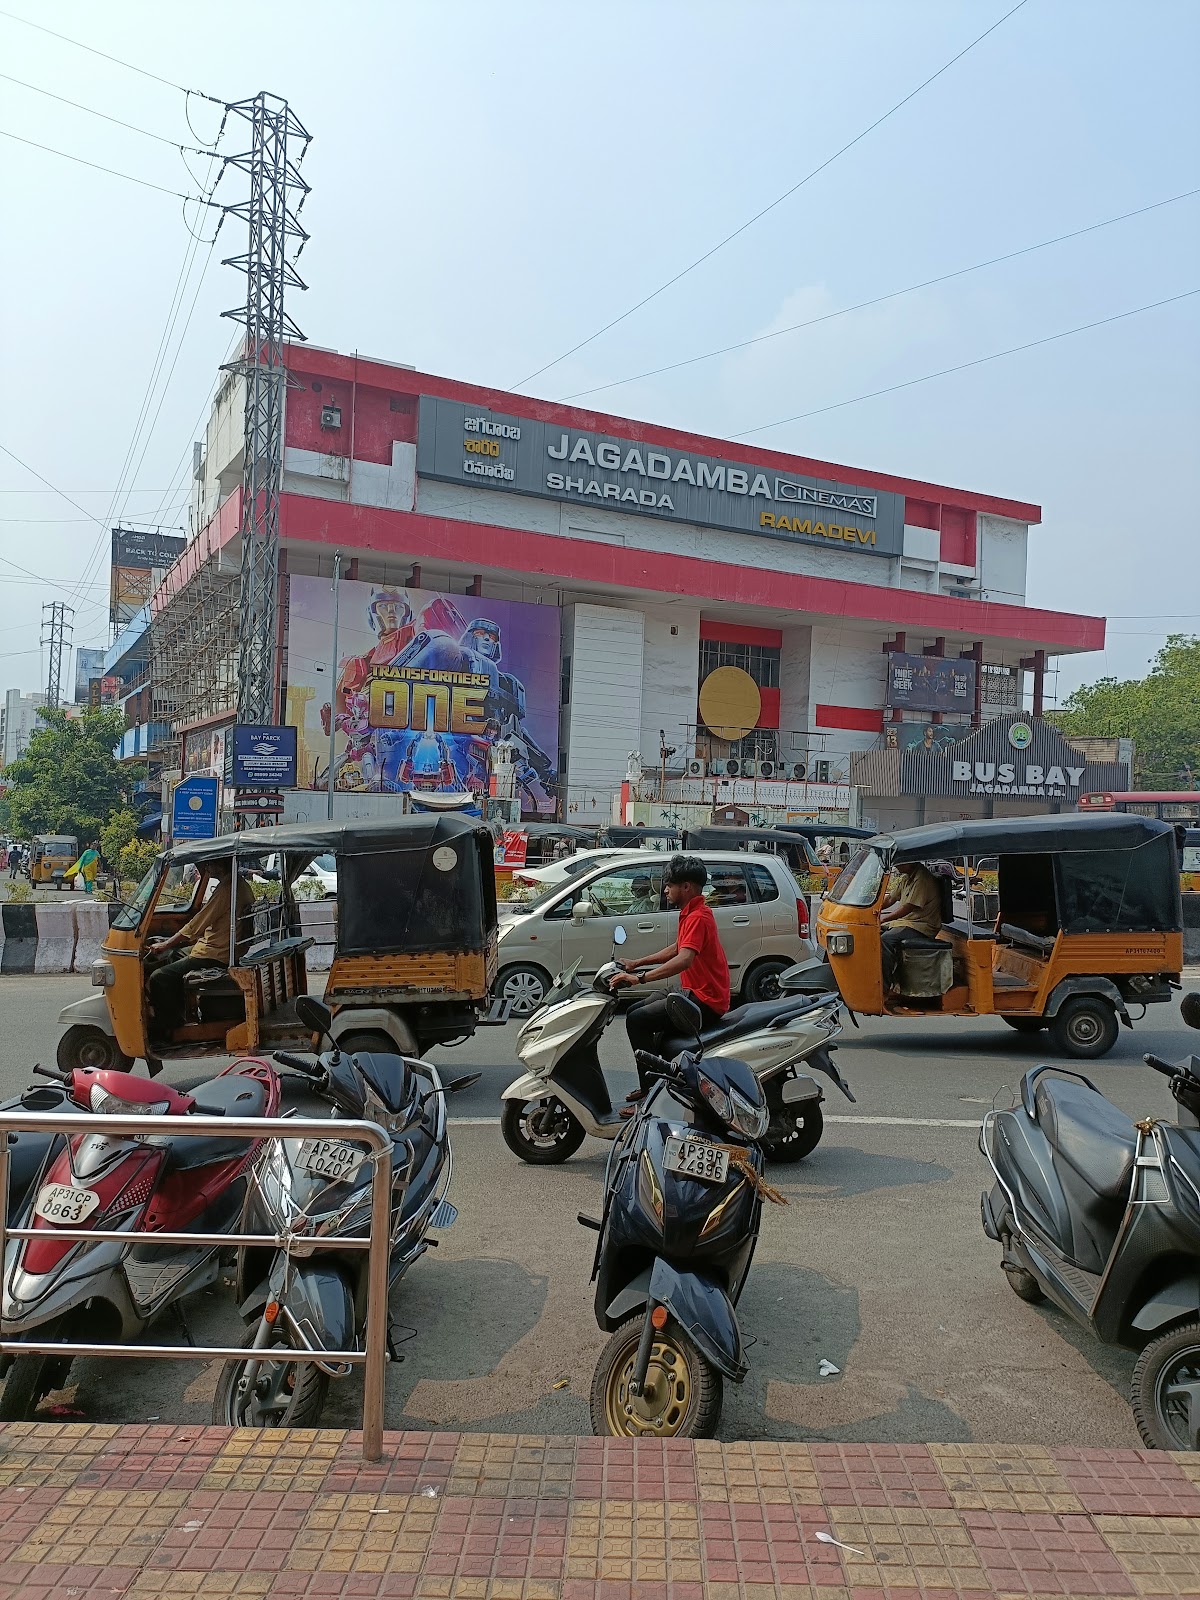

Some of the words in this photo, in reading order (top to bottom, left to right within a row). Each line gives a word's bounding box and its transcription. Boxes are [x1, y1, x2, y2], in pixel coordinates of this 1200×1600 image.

[547, 433, 772, 500] JAGADAMBA
[779, 482, 874, 515] CINEMAS
[546, 473, 675, 511] SHARADA
[759, 511, 877, 546] RAMADEVI
[125, 547, 146, 556] BACK
[370, 664, 490, 687] TRANSFORMERS
[894, 668, 912, 679] HIDE
[893, 679, 913, 691] SEEK
[369, 679, 489, 735] ONE
[952, 760, 1016, 784] BUS
[1025, 764, 1086, 787] BAY
[969, 783, 1045, 797] JAGADAMBA
[1047, 786, 1066, 798] Jn.
[90, 1143, 107, 1151] TVS
[311, 1141, 355, 1166] AP40A
[678, 1142, 723, 1165] AP39R
[677, 1157, 723, 1179] Z4996
[49, 1187, 92, 1204] AP31CP
[42, 1201, 83, 1221] 0863
